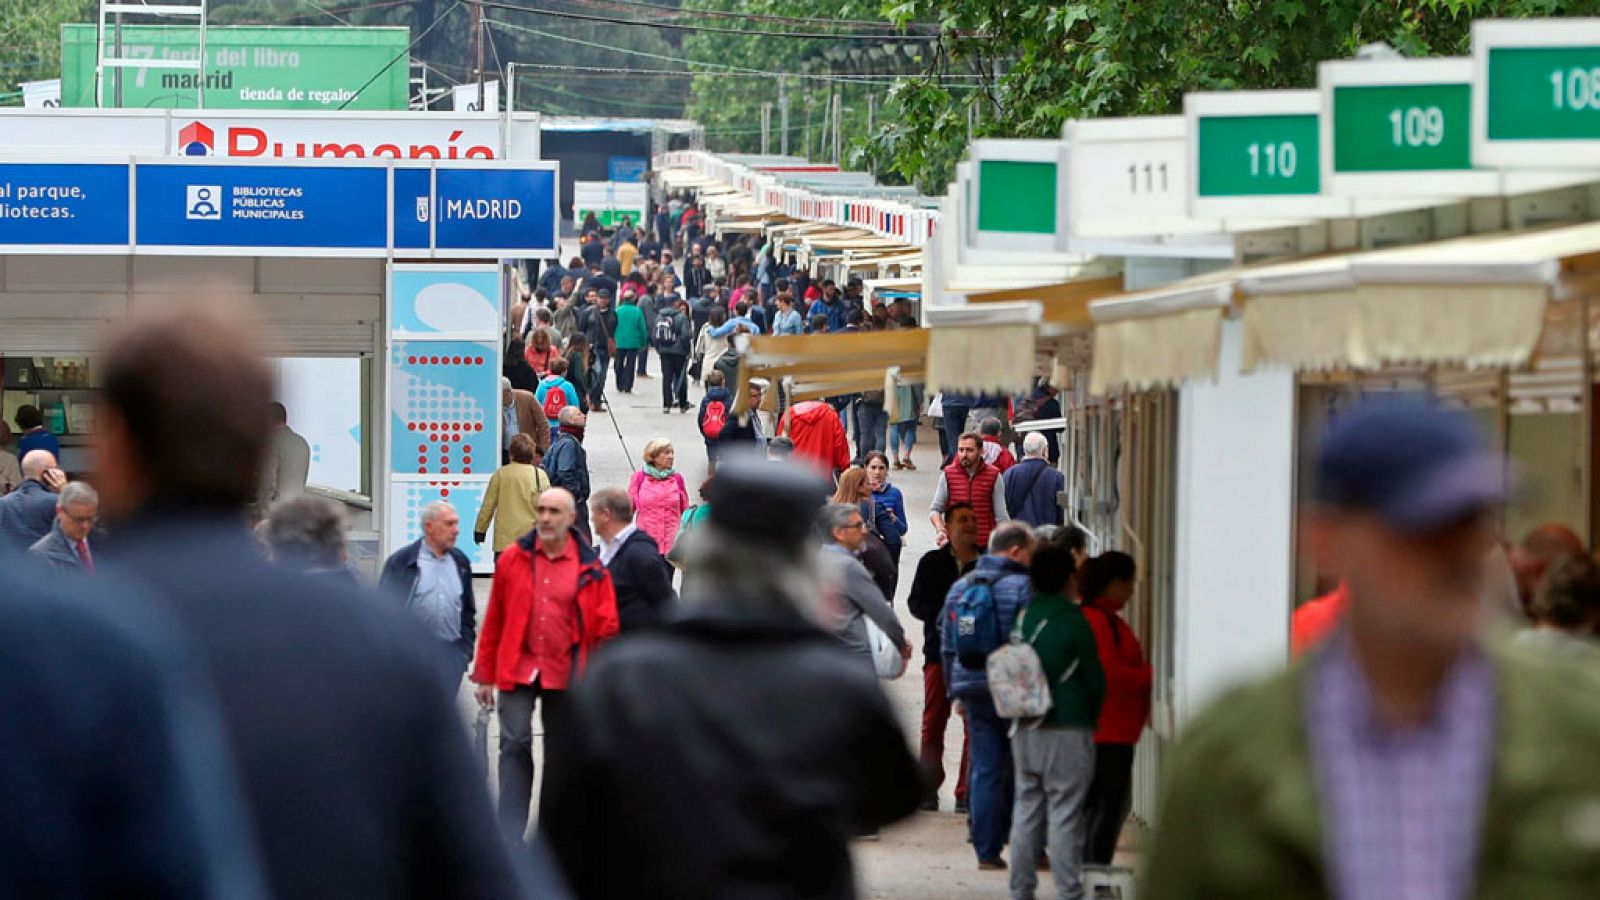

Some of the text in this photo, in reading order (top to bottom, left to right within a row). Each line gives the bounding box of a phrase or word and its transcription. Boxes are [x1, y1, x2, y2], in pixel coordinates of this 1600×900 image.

[216, 47, 248, 66] del
[254, 48, 300, 68] libro
[239, 87, 359, 104] tienda de regalos
[1389, 106, 1445, 146] 109
[1247, 141, 1297, 178] 110
[1127, 163, 1167, 193] 111
[17, 185, 87, 201] parque,
[232, 186, 303, 198] BIBLIOTECAS
[232, 196, 285, 209] PÚBLICAS
[447, 199, 522, 220] MADRID
[232, 209, 304, 220] MUNICIPALES
